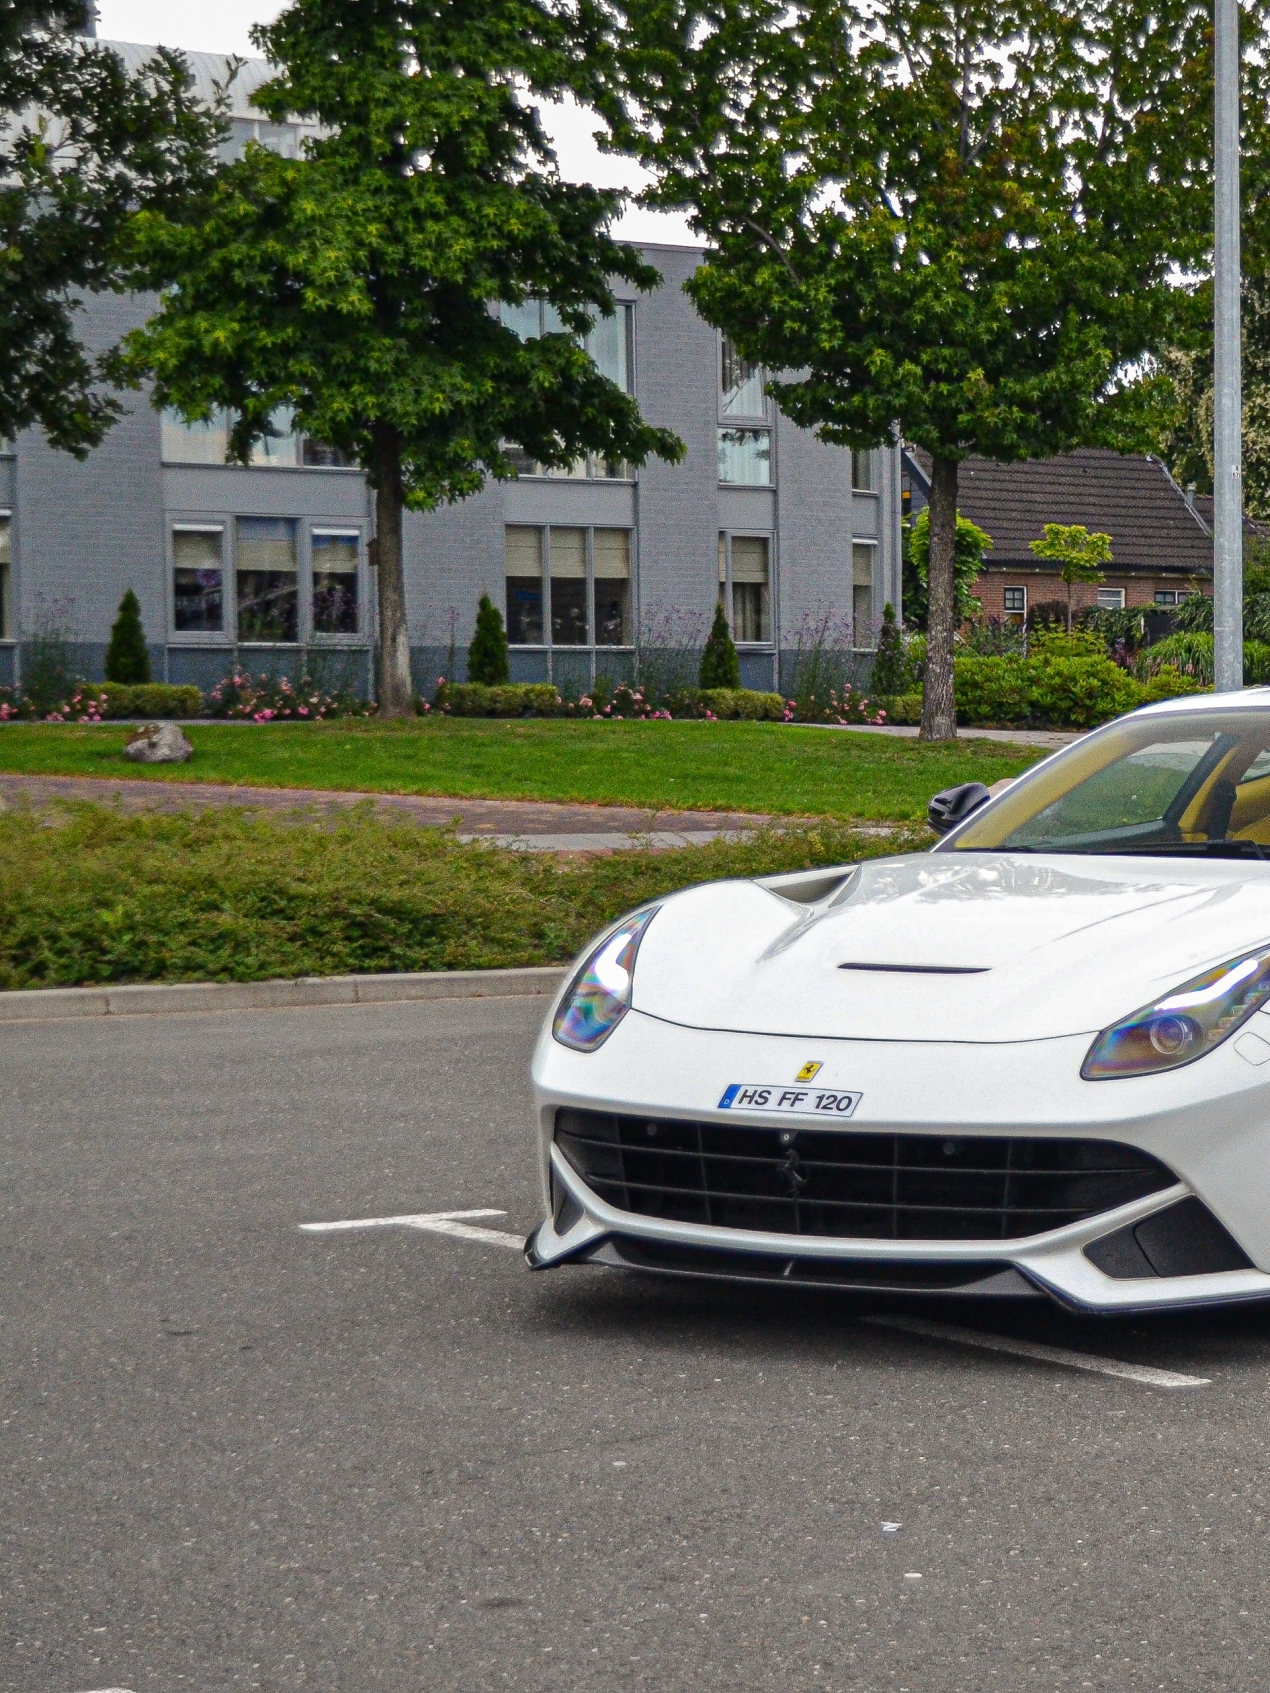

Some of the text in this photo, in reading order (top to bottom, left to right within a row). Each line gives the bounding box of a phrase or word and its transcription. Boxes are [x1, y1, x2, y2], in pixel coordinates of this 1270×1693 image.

[738, 1089, 853, 1112] HS FF 120
